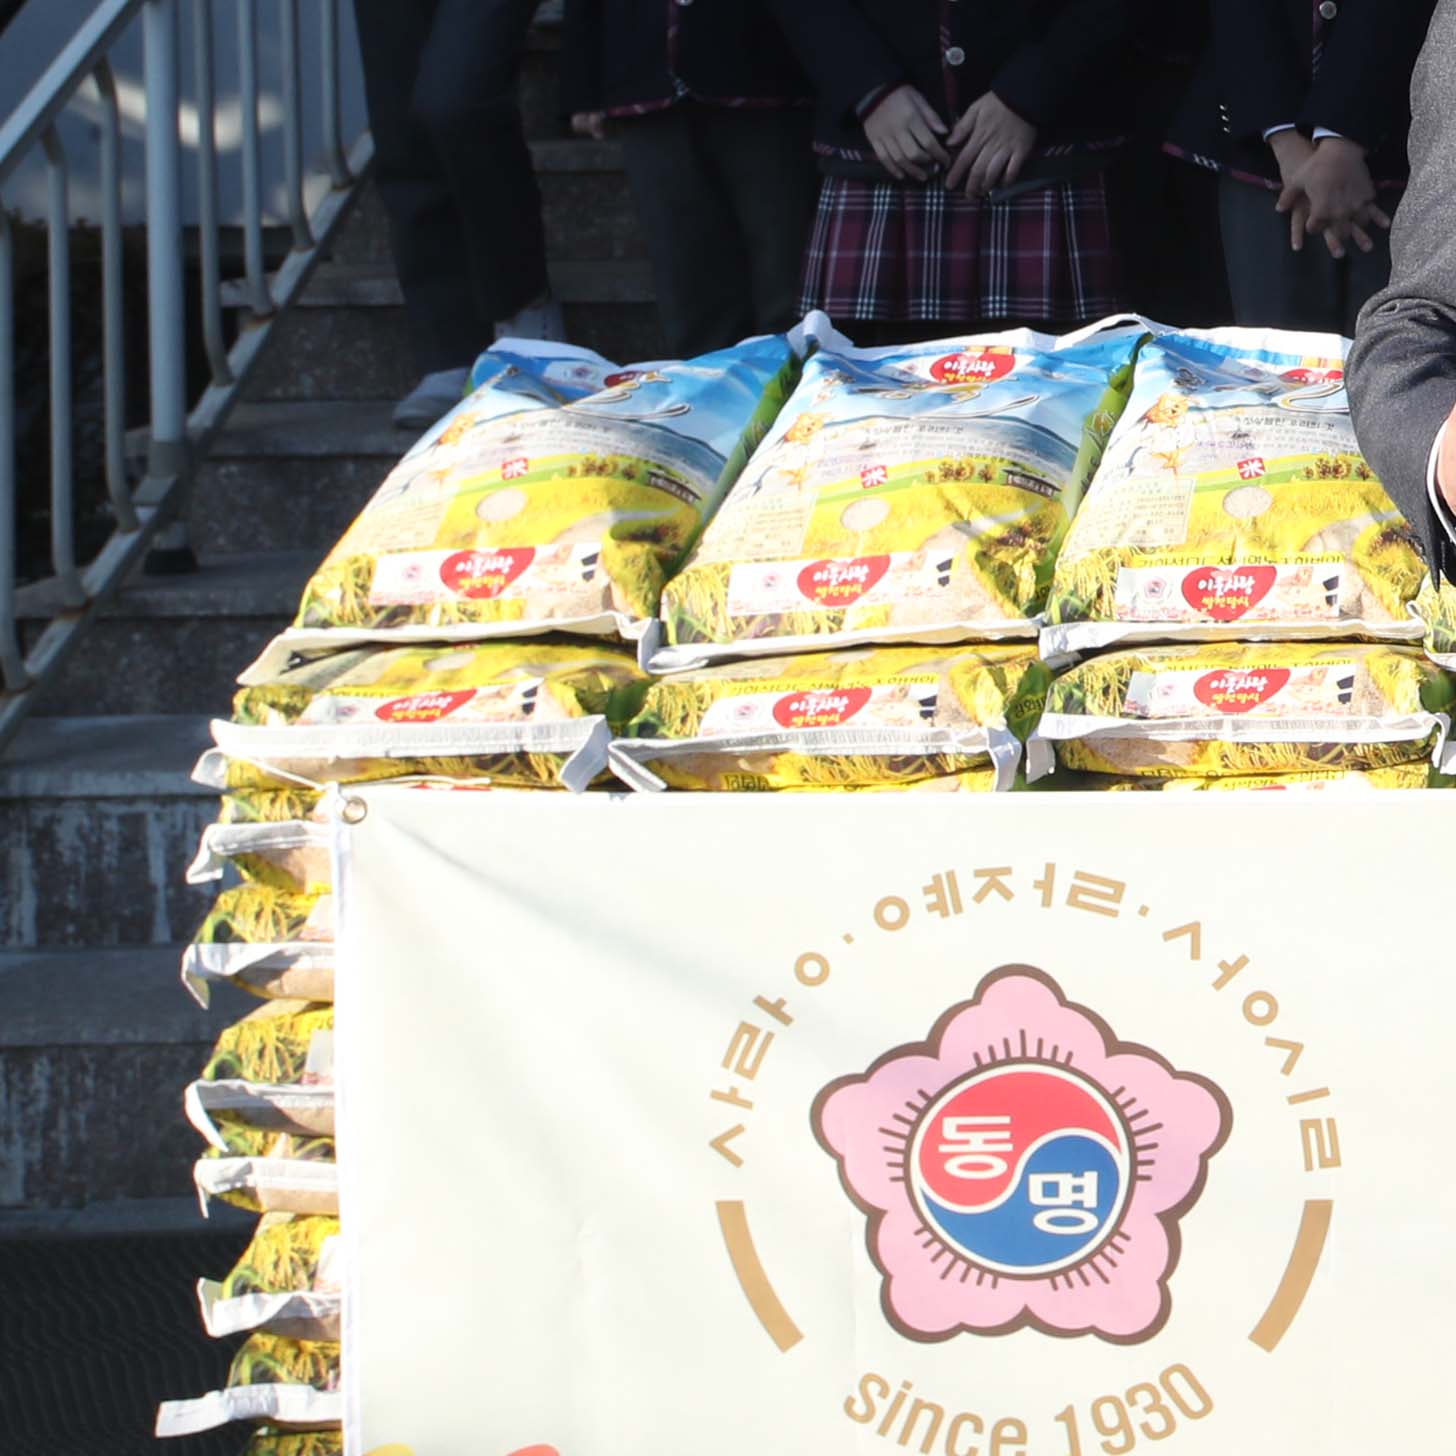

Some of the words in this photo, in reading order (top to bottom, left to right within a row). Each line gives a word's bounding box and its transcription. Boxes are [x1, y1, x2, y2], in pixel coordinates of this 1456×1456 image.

[1198, 575, 1255, 596] 이웃사랑
[843, 1372, 1029, 1456] since
[1053, 1362, 1215, 1456] 1930
